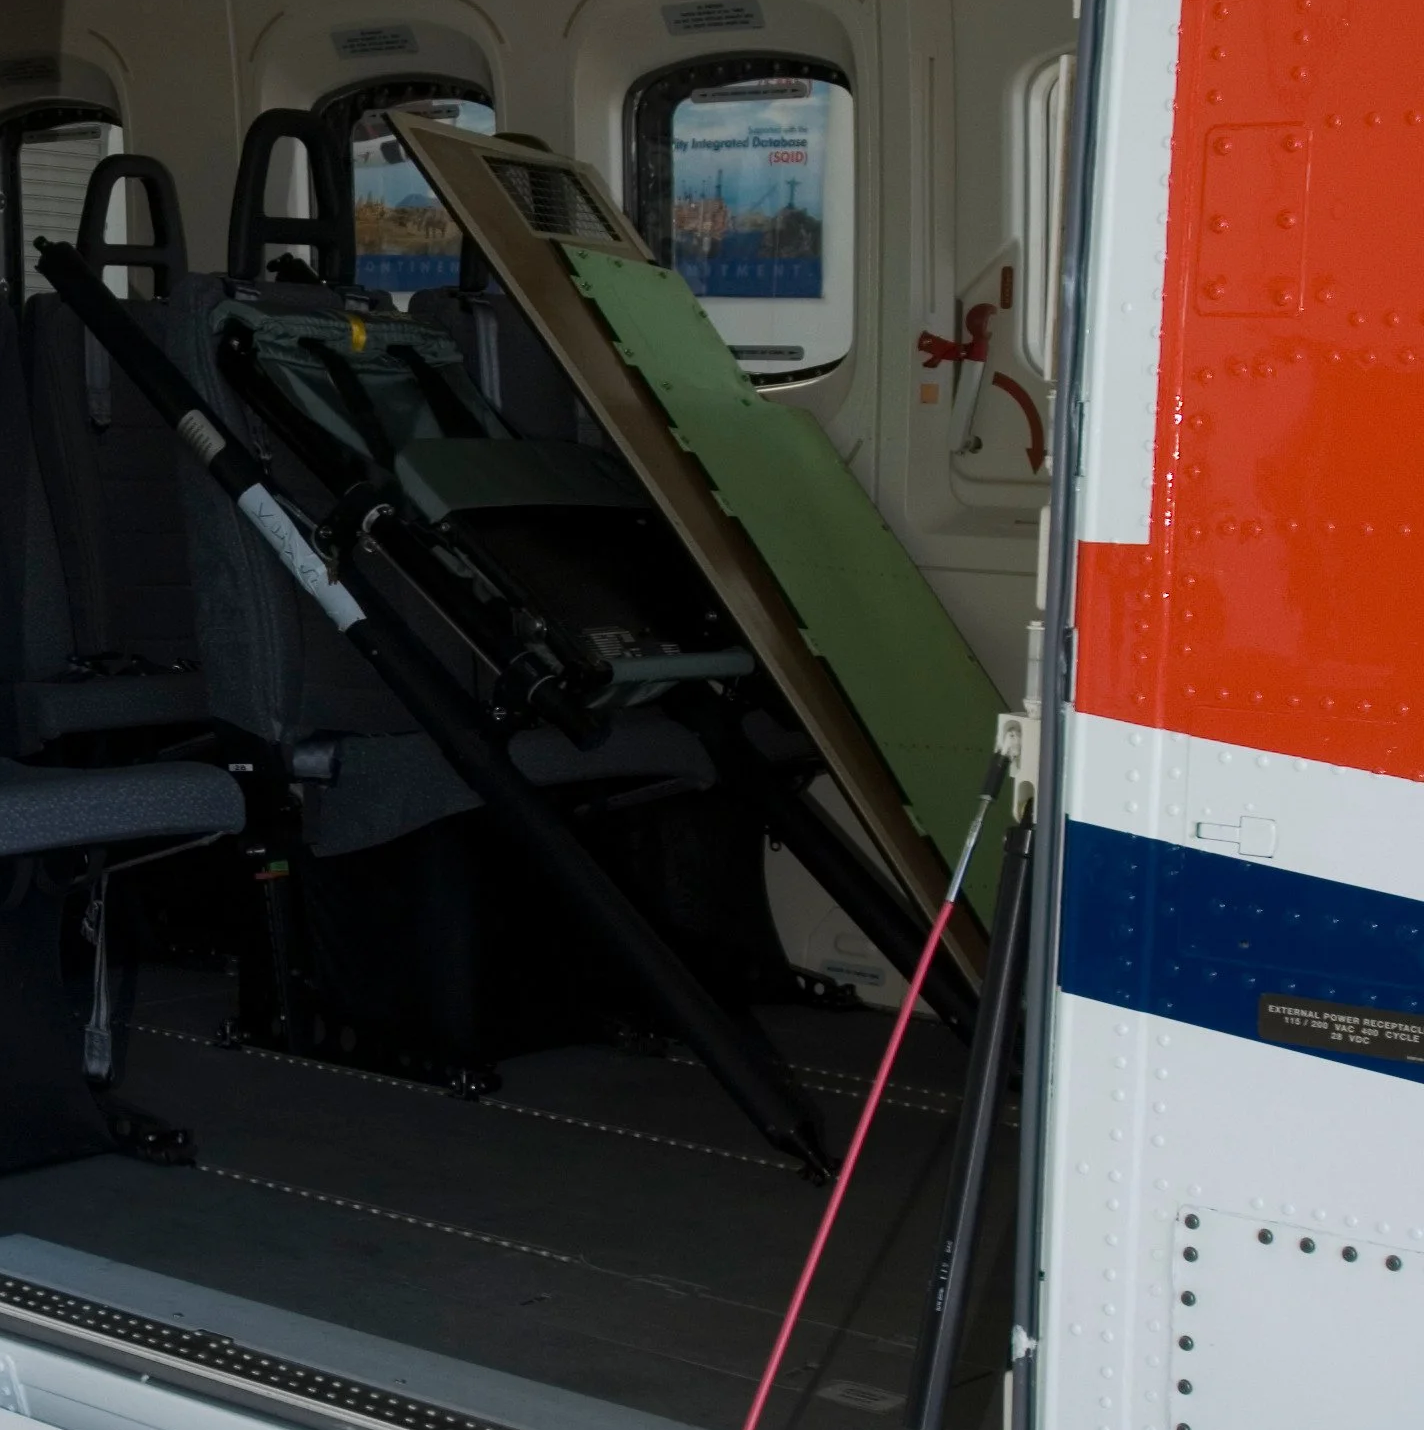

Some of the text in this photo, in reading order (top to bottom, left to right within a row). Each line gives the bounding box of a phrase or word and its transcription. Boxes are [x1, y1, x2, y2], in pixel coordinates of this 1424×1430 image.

[691, 137, 750, 151] Integrated
[752, 136, 808, 148] Database
[769, 150, 808, 166] (SQID)
[1268, 1004, 1424, 1035] EXTERNAL POWER RECEPTACL
[1284, 1016, 1302, 1026] 115
[1310, 1020, 1329, 1030] 200
[1334, 1023, 1356, 1033] VAC
[1385, 1031, 1420, 1044] CYCLE
[1330, 1032, 1371, 1045] 28 VDC
